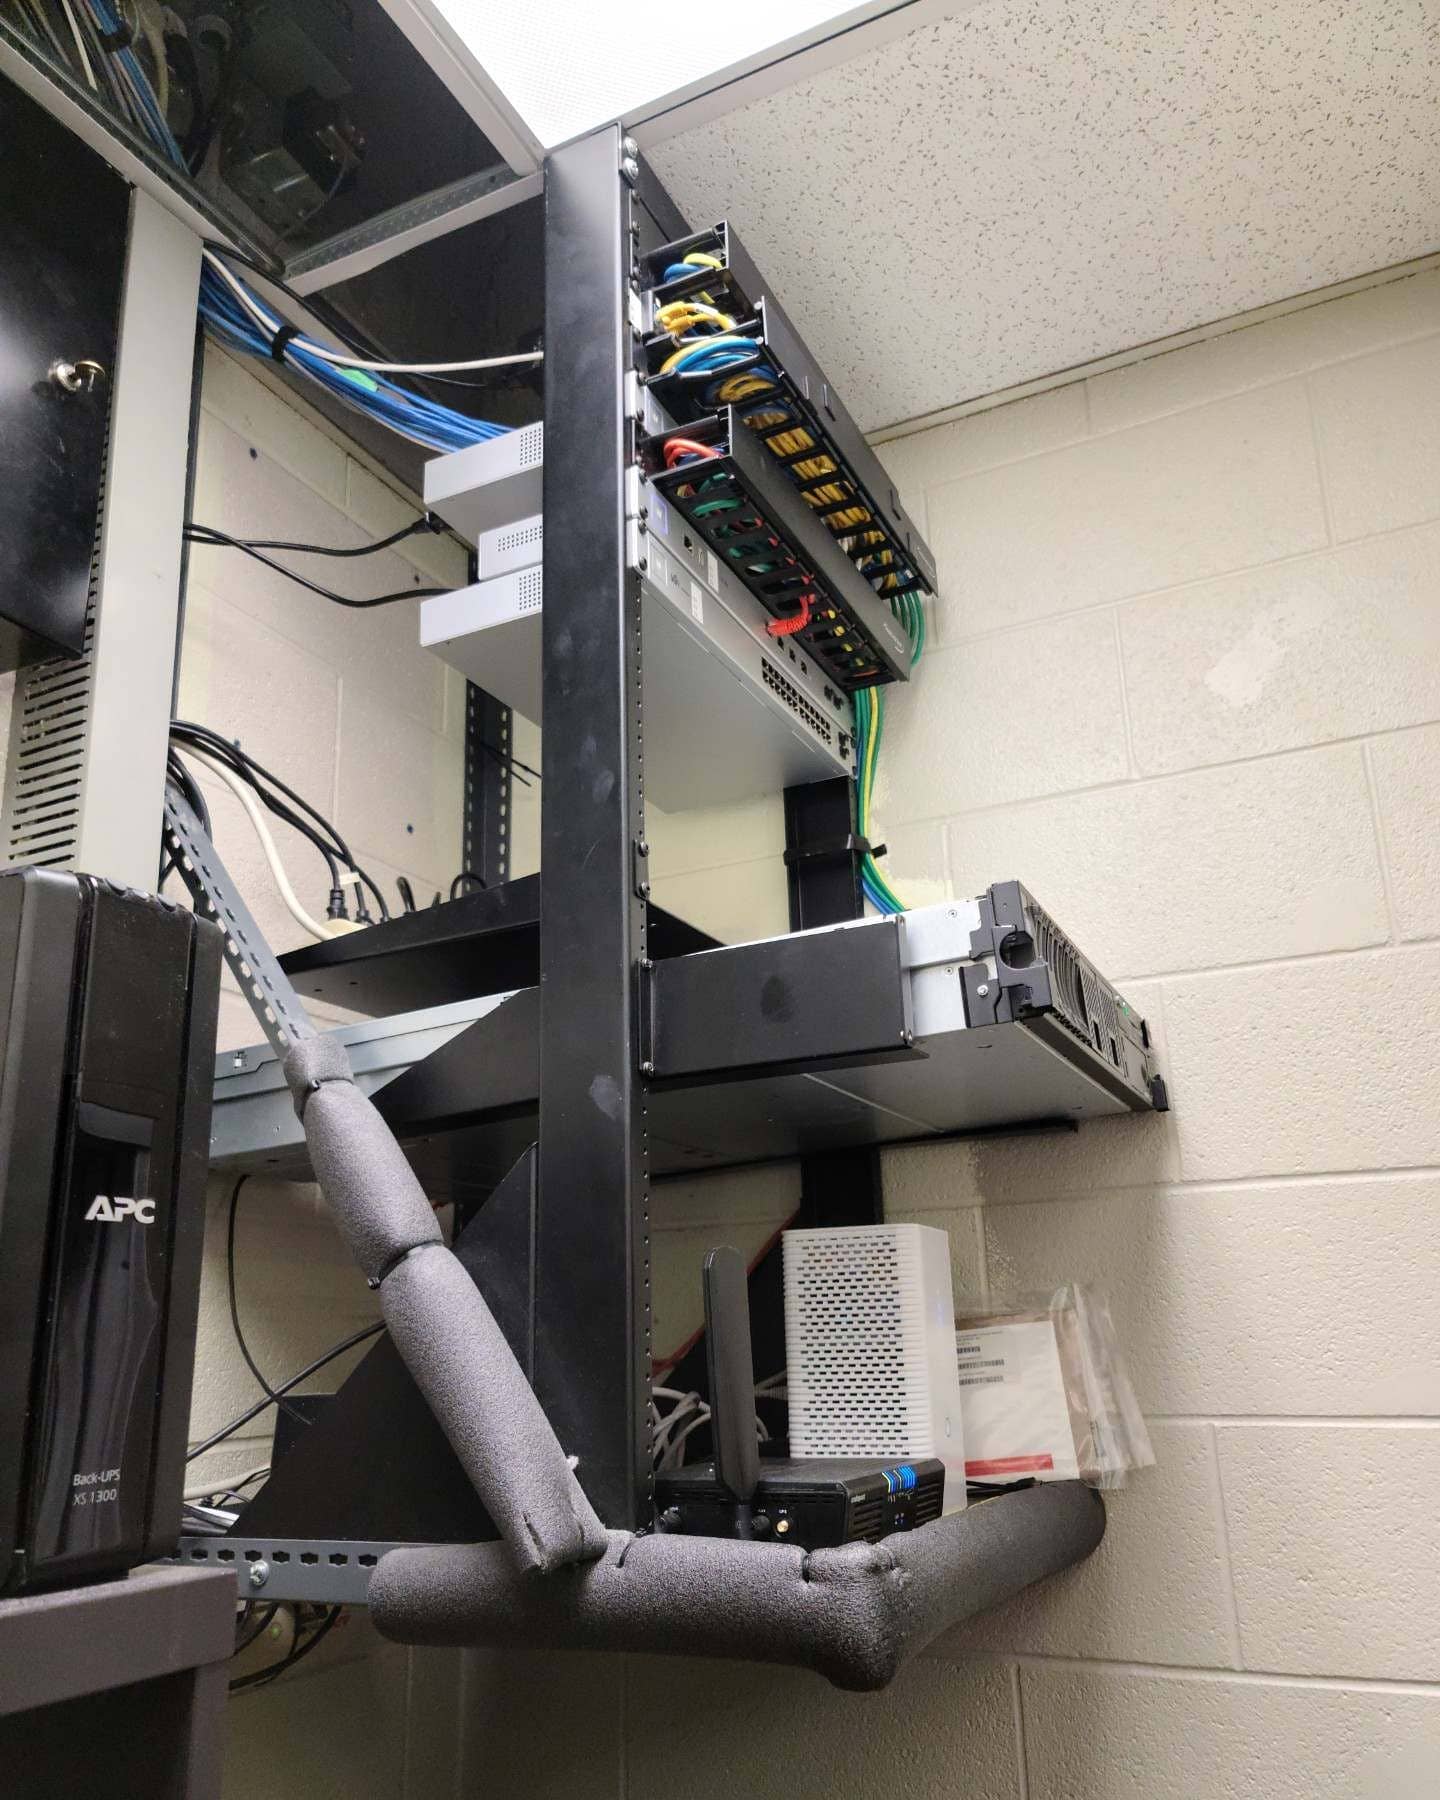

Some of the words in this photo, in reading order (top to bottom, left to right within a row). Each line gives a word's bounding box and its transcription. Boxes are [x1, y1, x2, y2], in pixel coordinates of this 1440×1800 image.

[84, 1194, 156, 1224] APC
[73, 1468, 121, 1486] Back-UPS
[73, 1491, 87, 1506] XS
[91, 1488, 117, 1504] 1300
